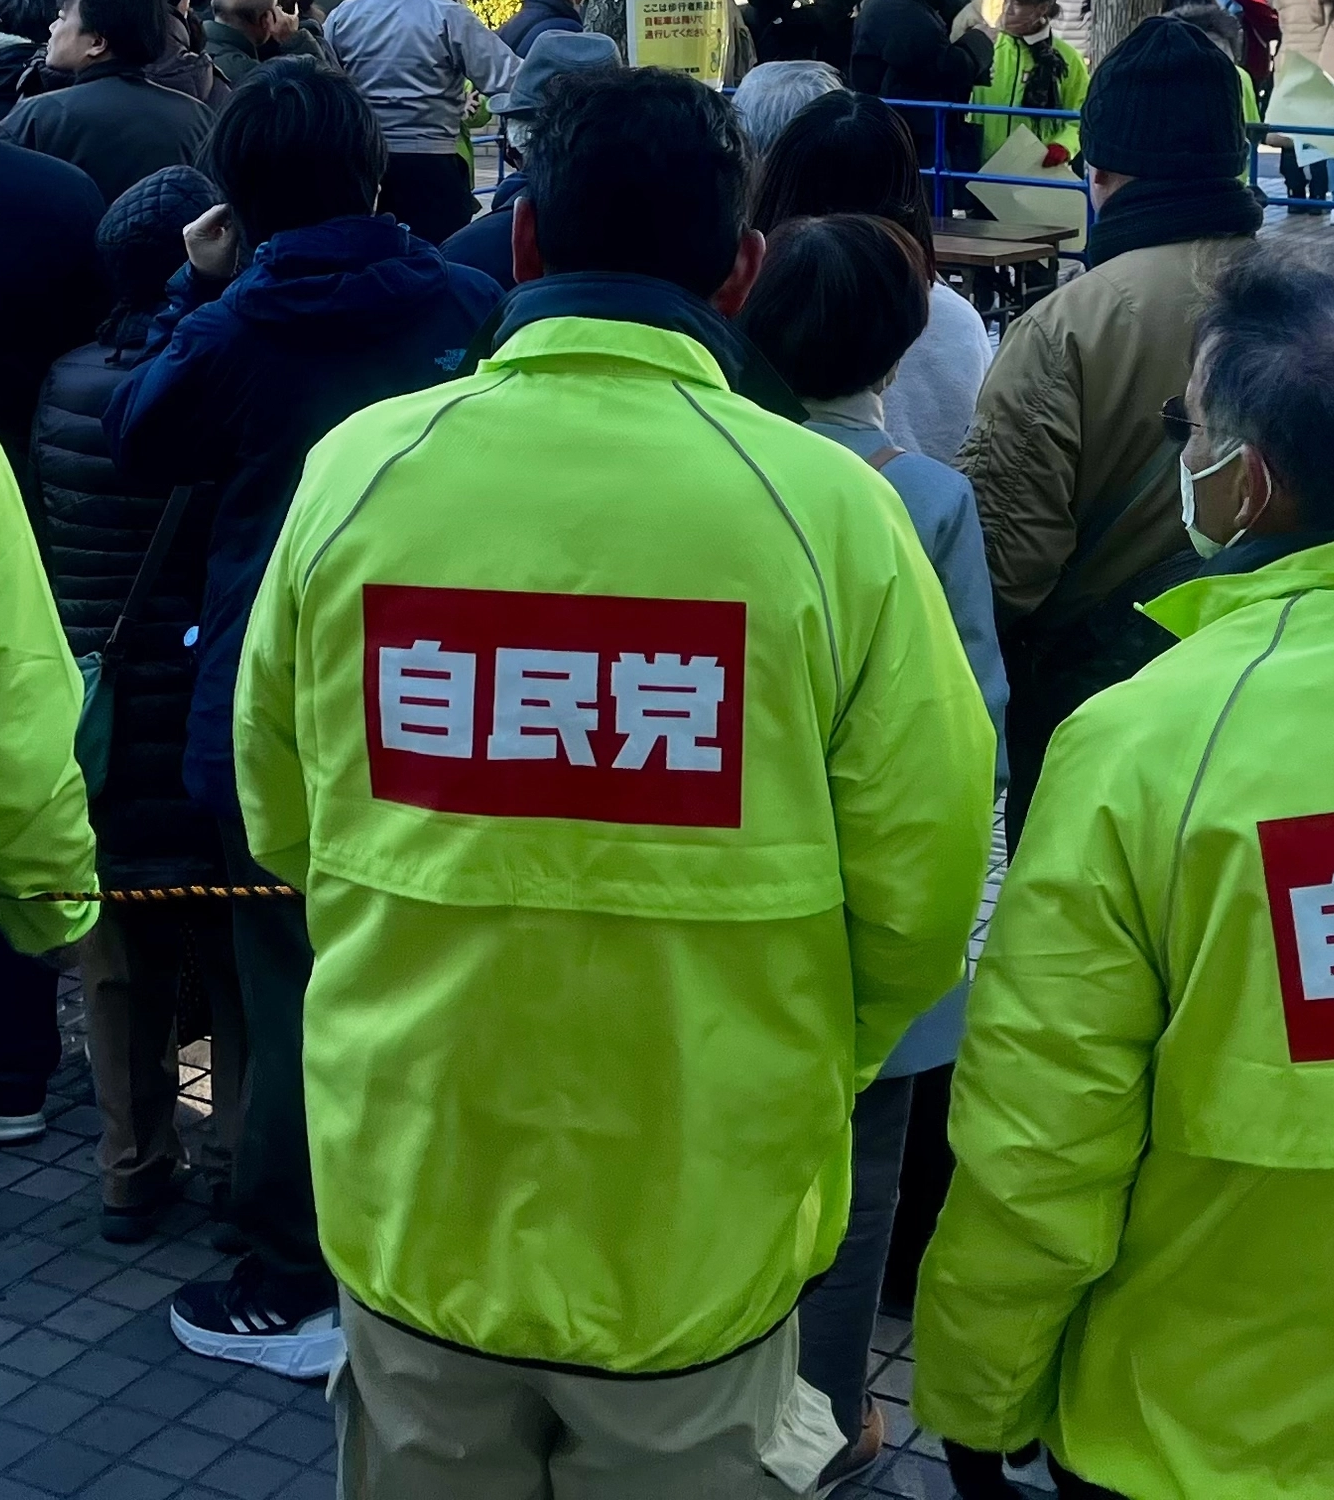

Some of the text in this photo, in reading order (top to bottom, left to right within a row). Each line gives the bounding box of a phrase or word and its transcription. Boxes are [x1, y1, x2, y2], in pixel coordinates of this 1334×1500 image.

[645, 14, 705, 27] 自転車は降りて
[379, 639, 725, 772] 自民党
